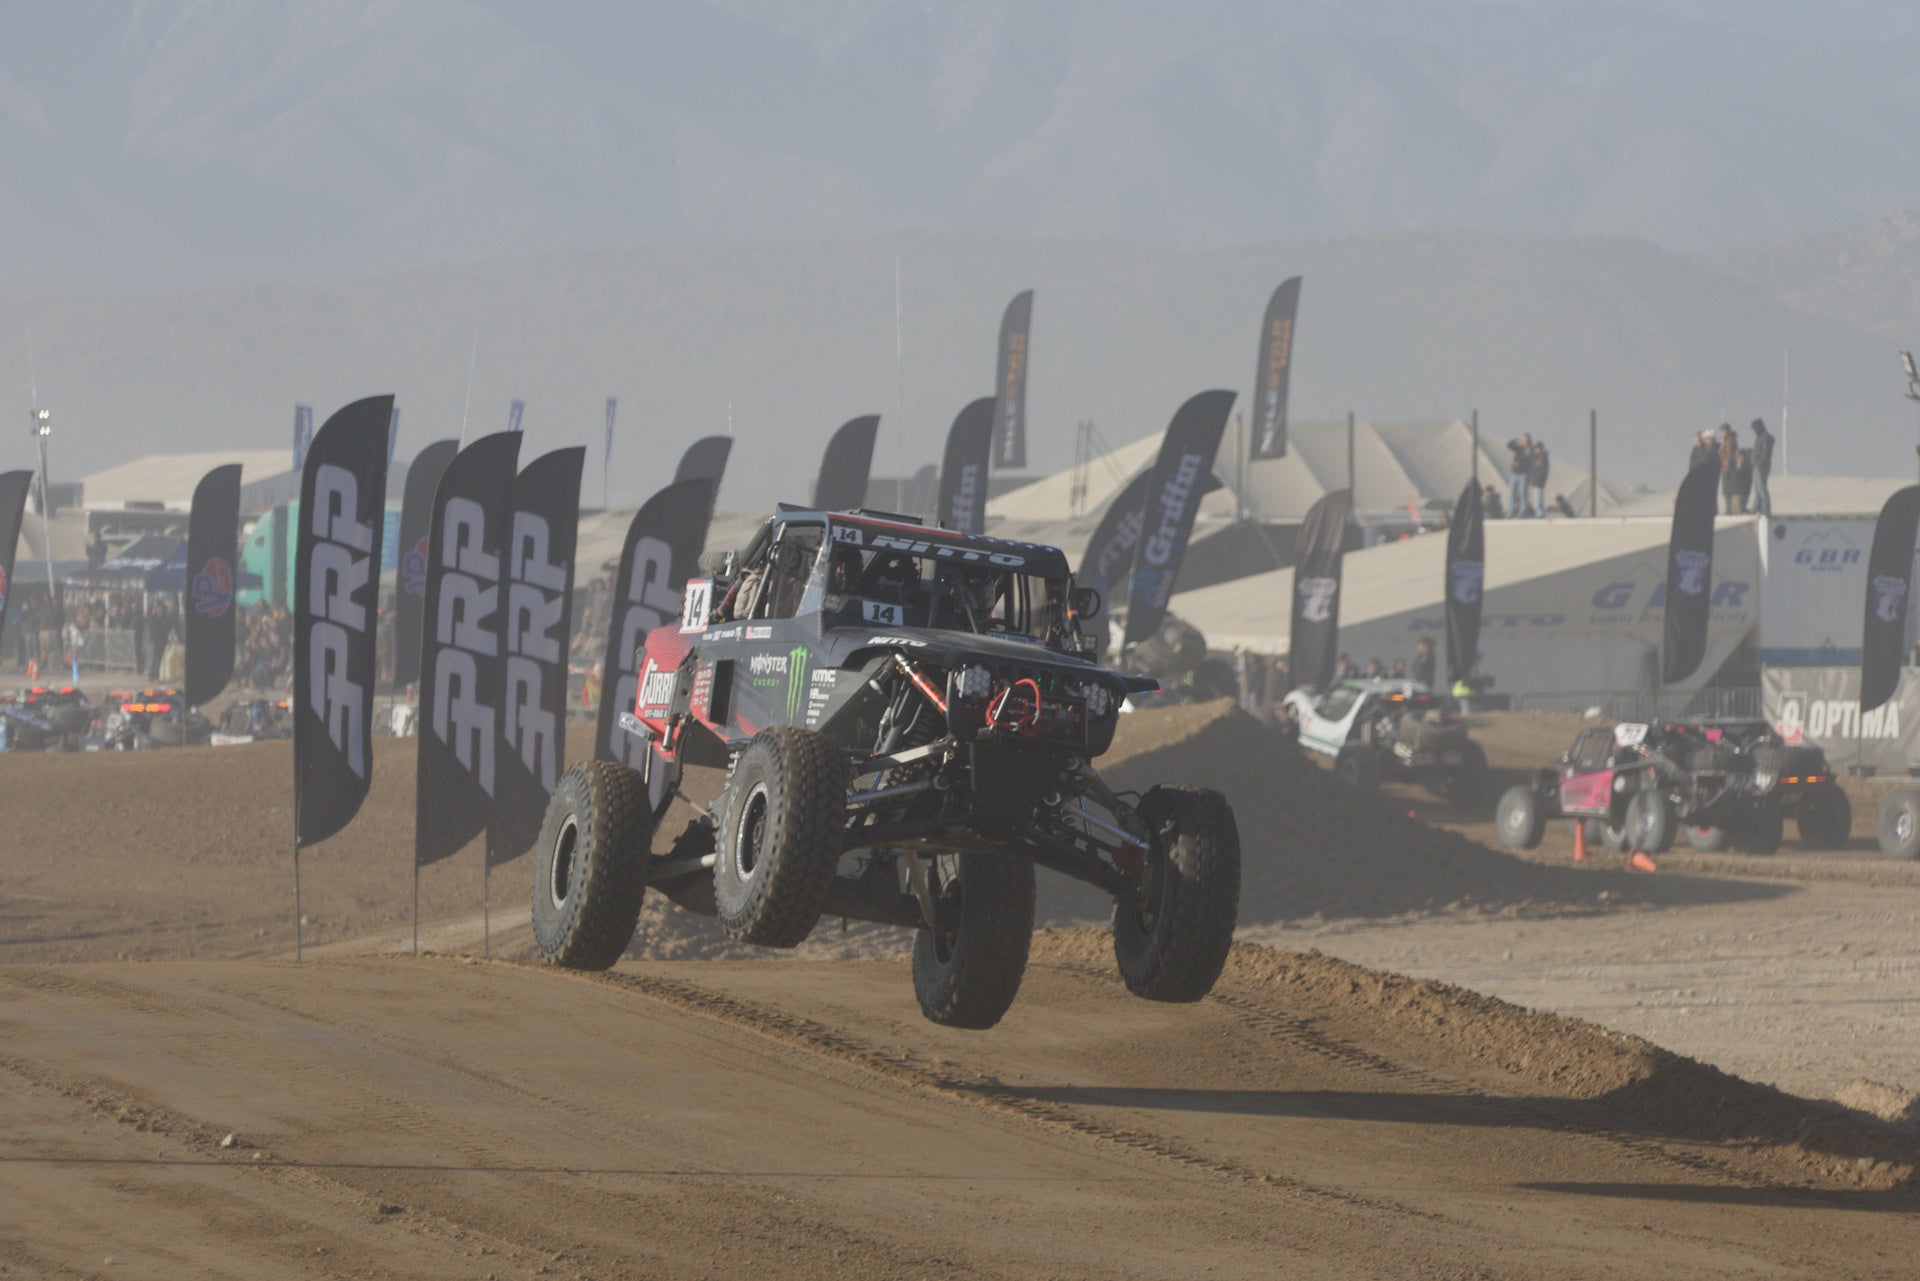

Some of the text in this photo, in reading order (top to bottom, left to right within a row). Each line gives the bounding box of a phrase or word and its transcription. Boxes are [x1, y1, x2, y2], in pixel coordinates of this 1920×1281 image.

[1144, 453, 1202, 566] Griffin
[838, 528, 857, 542] 14
[871, 534, 1026, 567] NITTO
[309, 463, 374, 781] PRP
[686, 588, 706, 627] 14
[871, 604, 895, 622] 14
[1407, 613, 1567, 630] NTTO
[432, 497, 500, 800] PRP
[504, 511, 568, 797] PRP
[867, 636, 928, 648] NITTO
[638, 657, 676, 709] CURRI
[750, 652, 787, 675] MONSTER
[1808, 699, 1900, 739] OPTIMA
